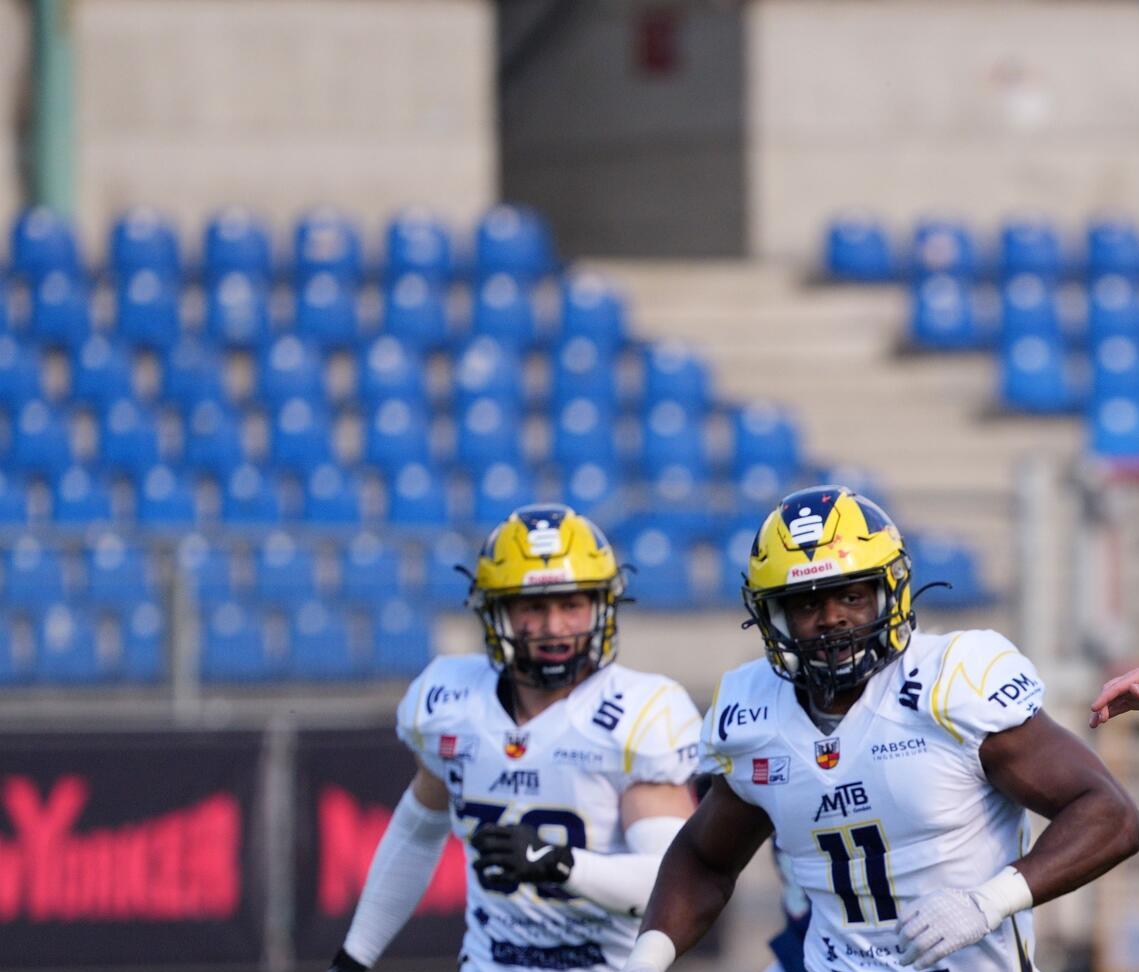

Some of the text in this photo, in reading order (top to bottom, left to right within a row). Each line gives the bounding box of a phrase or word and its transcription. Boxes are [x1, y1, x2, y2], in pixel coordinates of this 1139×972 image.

[792, 562, 832, 577] Riddell
[988, 672, 1035, 708] TDM
[737, 705, 769, 727] EVI
[871, 738, 927, 755] PABSCH
[813, 781, 869, 822] MTB
[815, 822, 900, 927] 11
